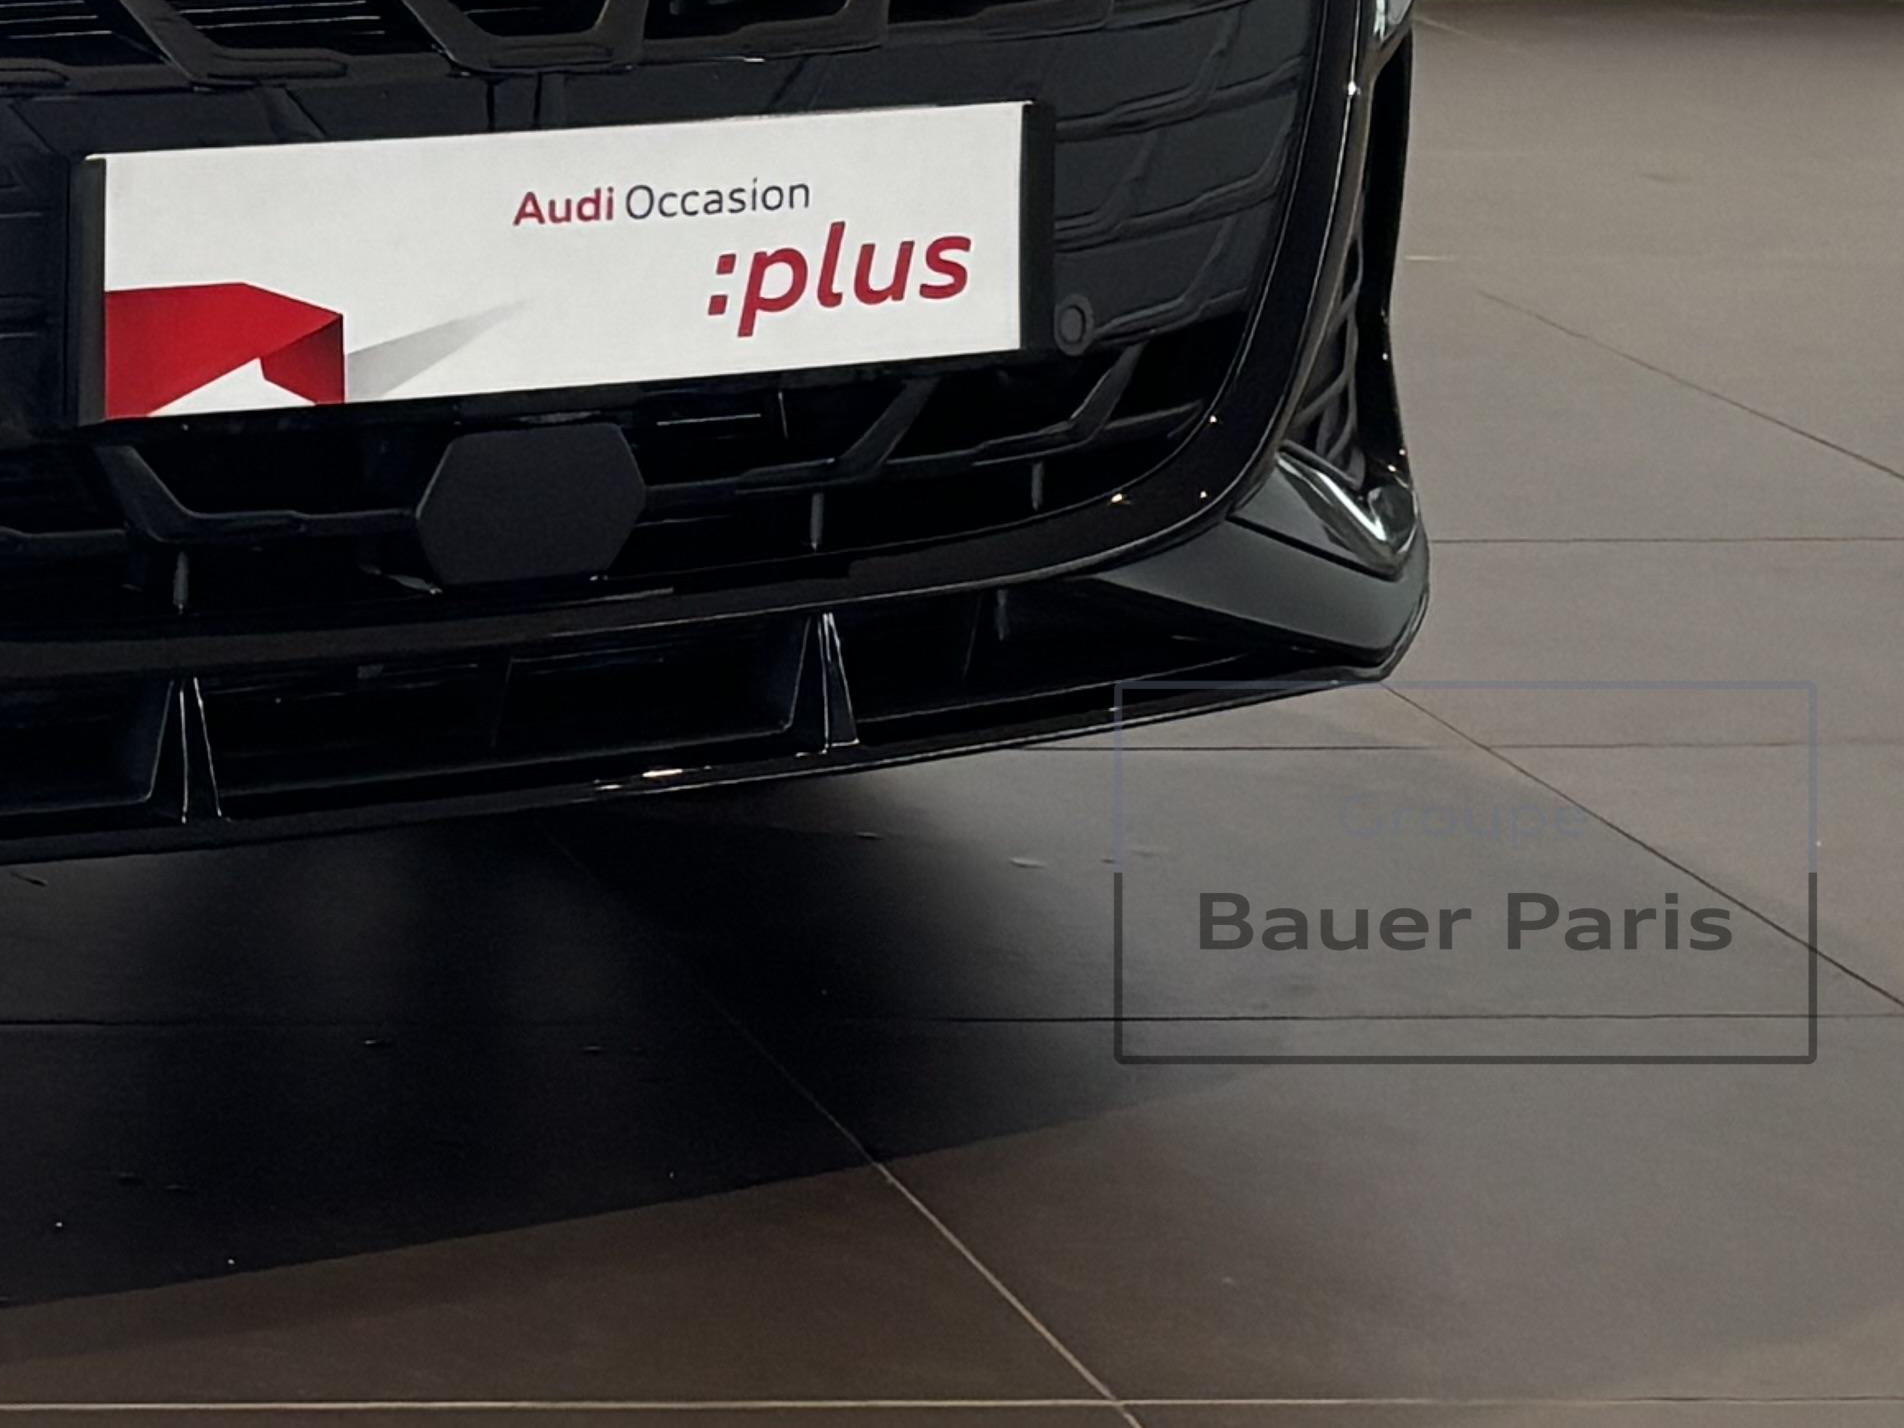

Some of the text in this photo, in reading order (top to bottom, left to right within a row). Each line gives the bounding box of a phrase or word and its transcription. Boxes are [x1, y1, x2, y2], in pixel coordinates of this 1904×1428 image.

[513, 178, 810, 226] Audi Occasion
[708, 221, 972, 338] :plus
